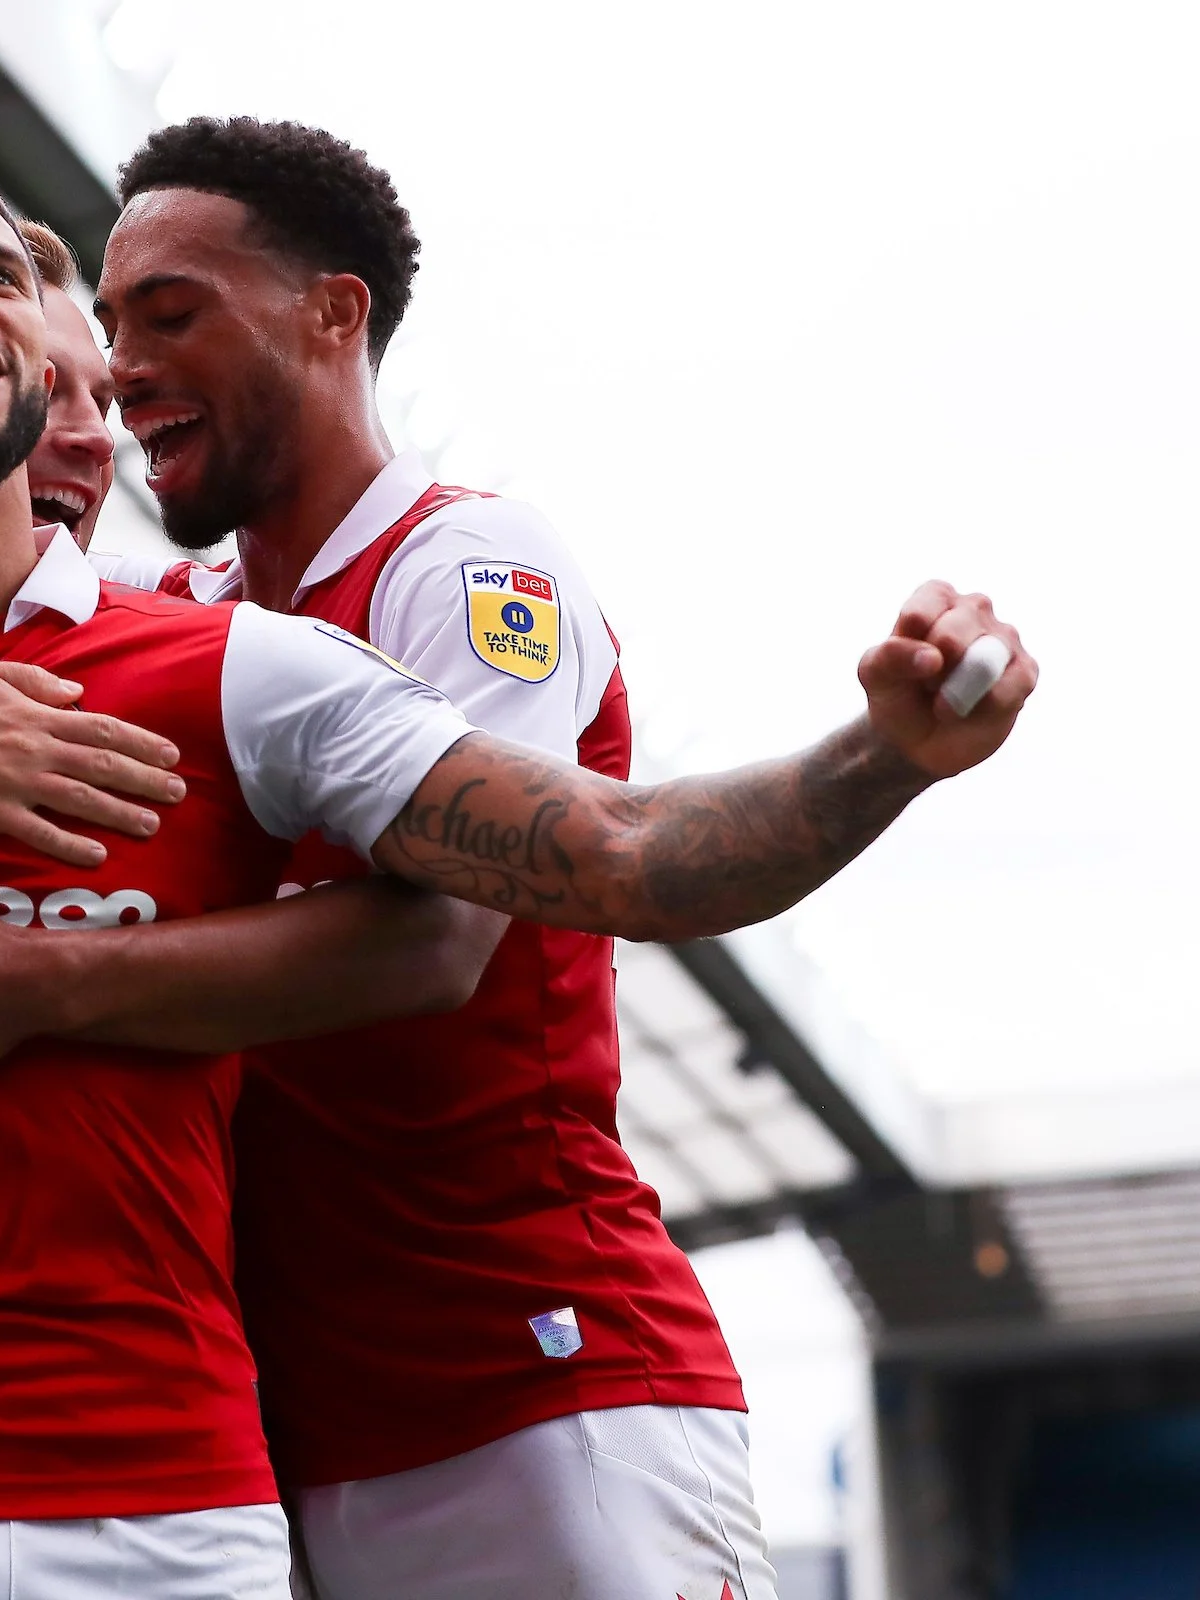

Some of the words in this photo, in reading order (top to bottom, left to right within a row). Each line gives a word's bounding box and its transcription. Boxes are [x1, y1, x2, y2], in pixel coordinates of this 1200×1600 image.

[472, 569, 509, 589] sky
[516, 572, 549, 595] bet
[483, 631, 519, 645] TAKE
[521, 636, 549, 655] TIME
[488, 642, 507, 653] TO
[509, 644, 548, 666] THINK
[392, 779, 564, 876] ichael
